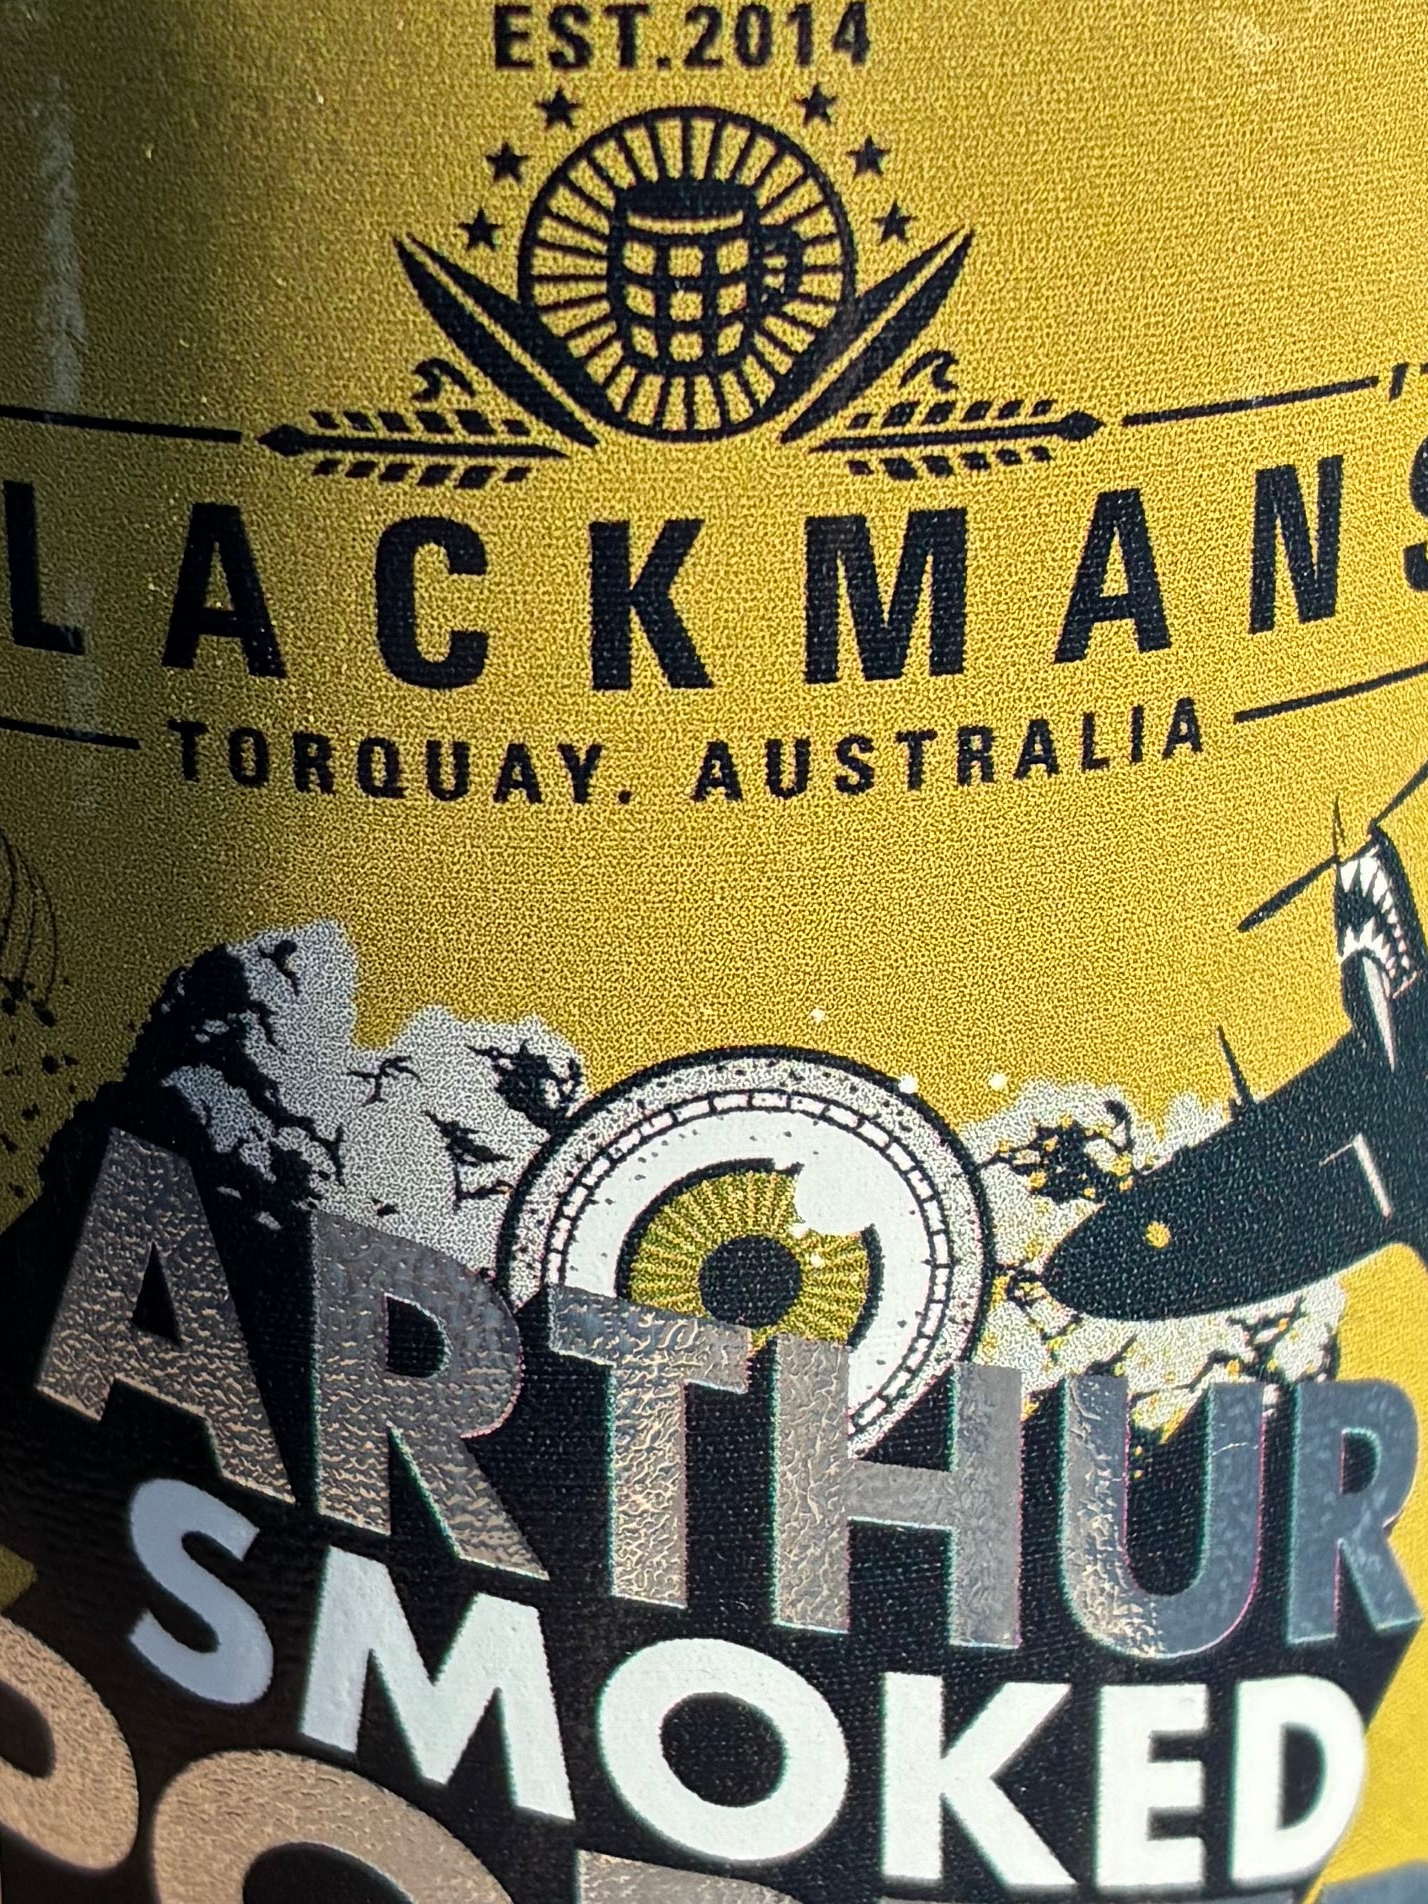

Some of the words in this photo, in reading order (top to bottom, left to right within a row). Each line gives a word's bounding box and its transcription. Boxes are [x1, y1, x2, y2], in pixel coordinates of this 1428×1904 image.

[691, 697, 1205, 803] AUSTRALIA
[33, 1131, 1421, 1659] ARTHUR
[124, 1476, 1368, 1894] SMOKED
